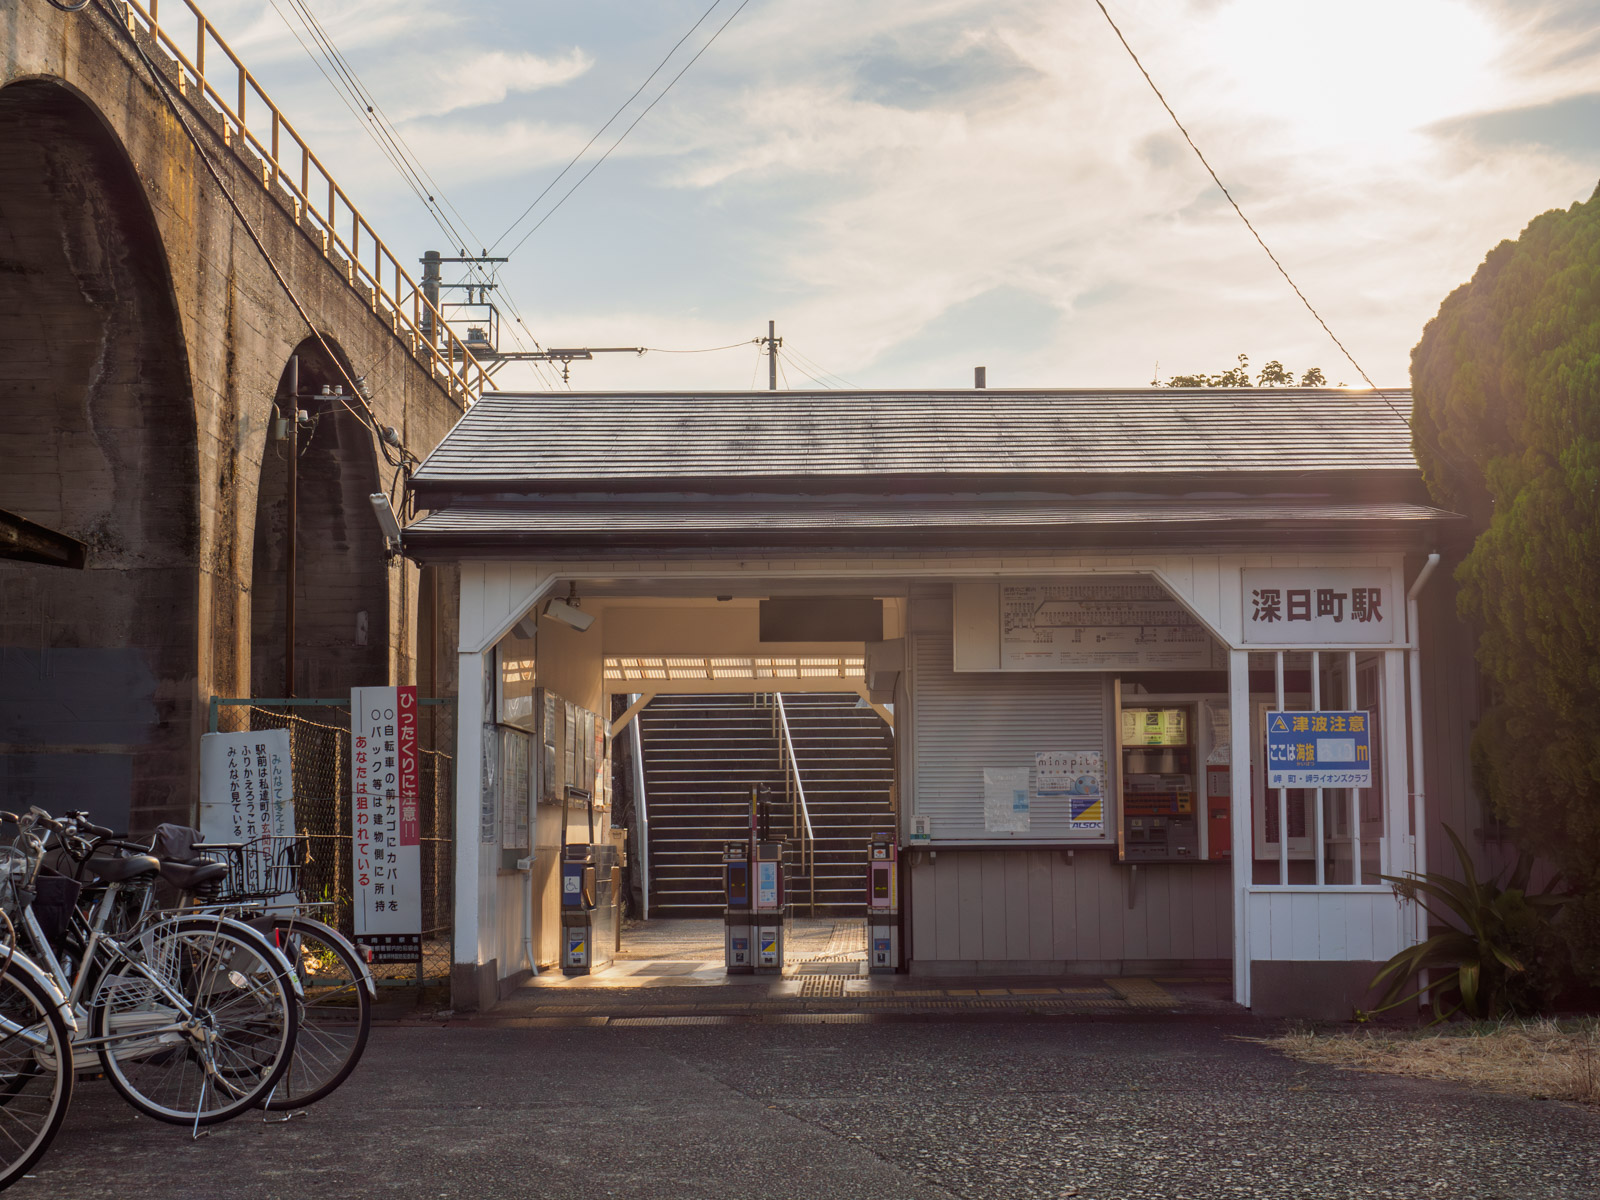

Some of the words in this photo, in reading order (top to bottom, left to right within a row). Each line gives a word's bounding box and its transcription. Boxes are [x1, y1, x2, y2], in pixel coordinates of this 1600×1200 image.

[1252, 588, 1383, 623] 深日町駅
[1292, 716, 1365, 732] 津波注意
[1270, 744, 1314, 761] ここは海抜
[1356, 745, 1368, 761] m
[1038, 756, 1098, 768] minapita
[355, 736, 370, 886] あなたは狙われている
